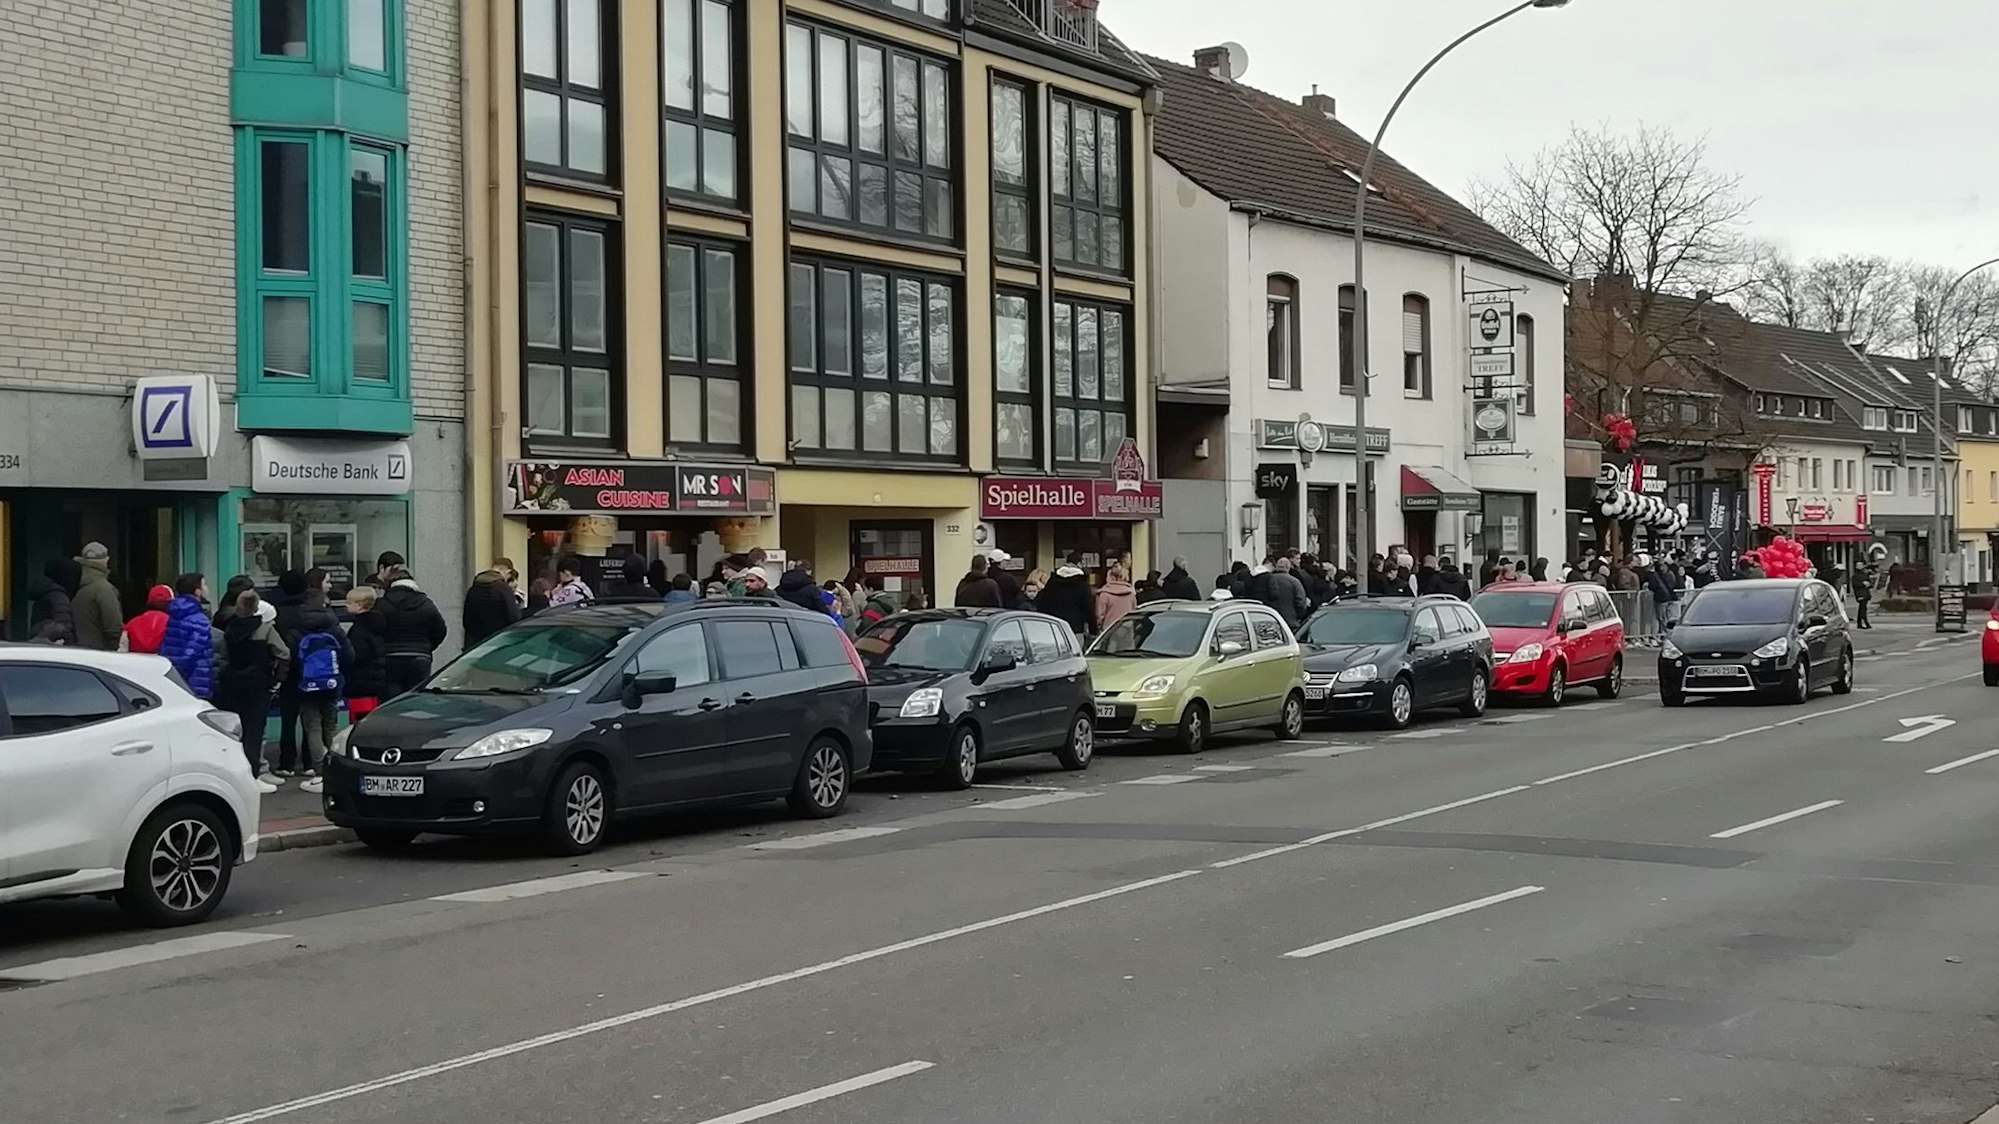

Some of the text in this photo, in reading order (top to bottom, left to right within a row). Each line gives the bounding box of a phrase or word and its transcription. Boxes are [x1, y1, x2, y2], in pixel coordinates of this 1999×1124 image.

[1365, 433, 1389, 447] TREFF
[0, 454, 20, 469] 334
[269, 461, 379, 480] Deutsche Bank
[565, 468, 624, 486] ASIAN
[683, 474, 742, 496] MR SON
[1261, 471, 1289, 491] sky
[597, 490, 671, 509] CUISINE
[987, 484, 1085, 511] Spielhalle
[1098, 495, 1161, 514] SPIELHALLE
[1407, 497, 1438, 506] Gaststätte
[947, 525, 960, 533] 332
[865, 559, 919, 573] SPIELHALLE
[1104, 707, 1114, 716] 77
[366, 778, 422, 792] BM AR 227
